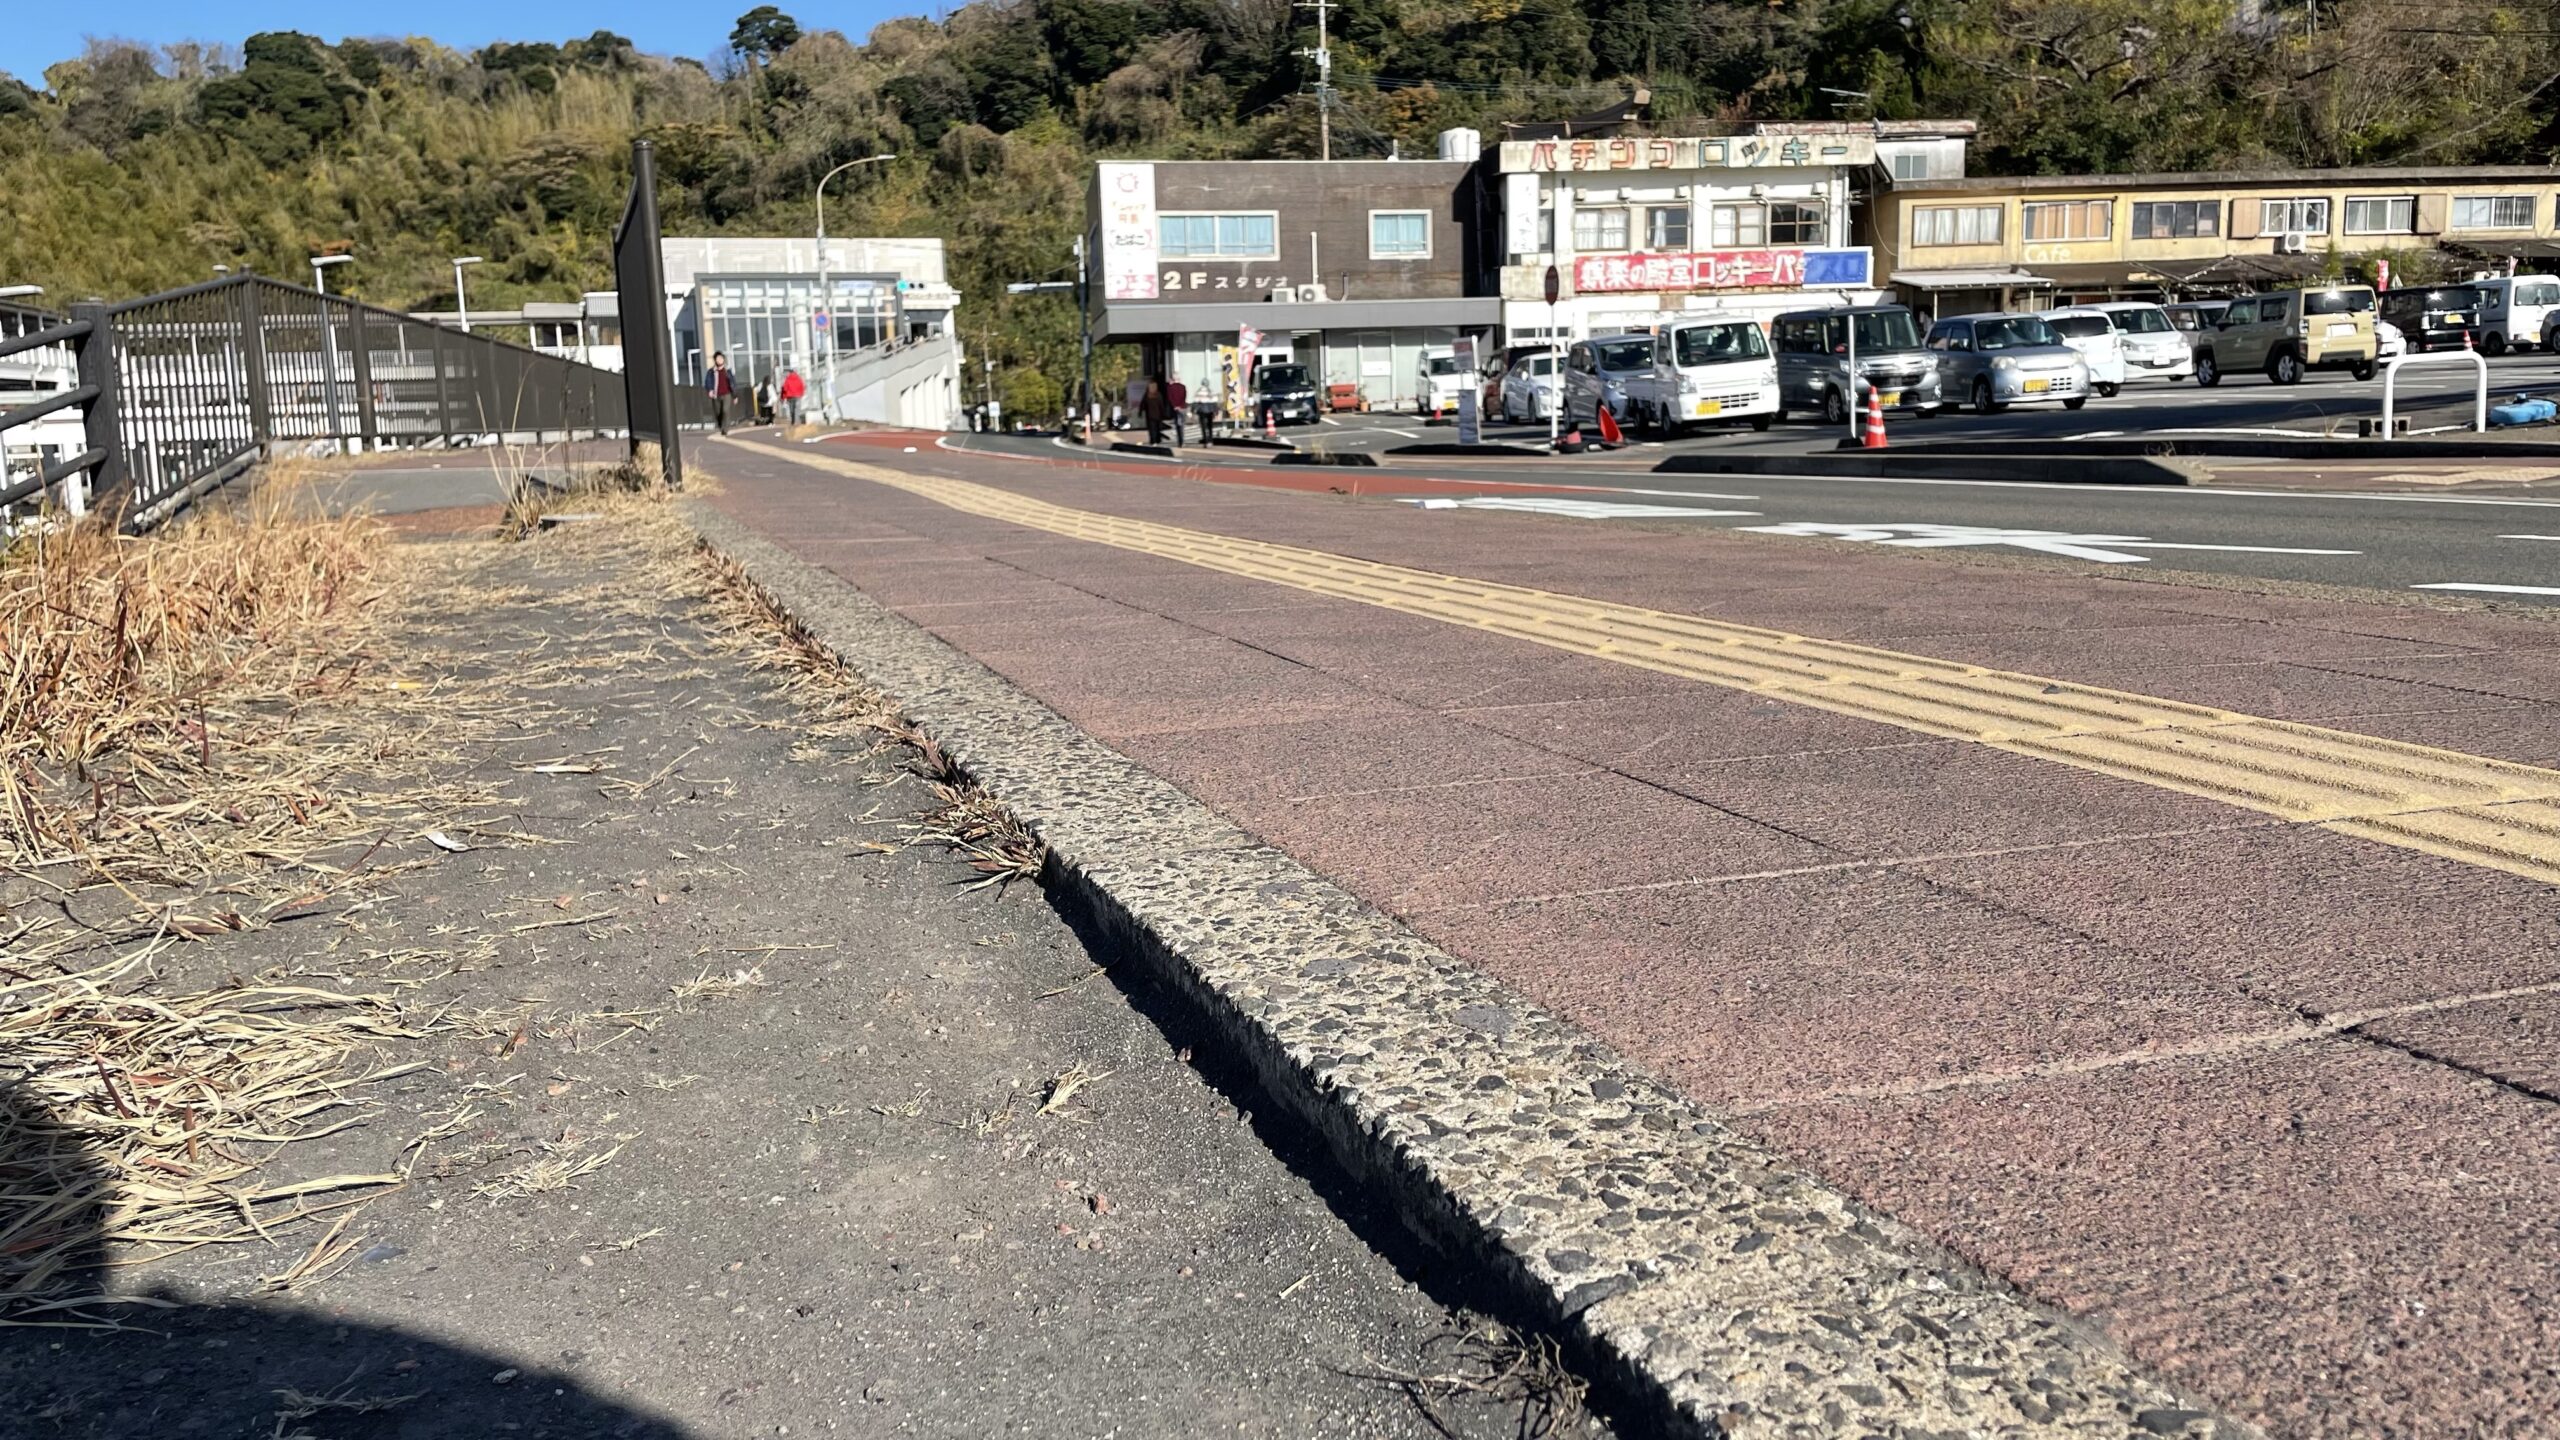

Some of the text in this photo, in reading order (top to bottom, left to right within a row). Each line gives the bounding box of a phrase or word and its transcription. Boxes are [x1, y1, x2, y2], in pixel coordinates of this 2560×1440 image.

[1530, 136, 1848, 171] パチンコ ロッキー
